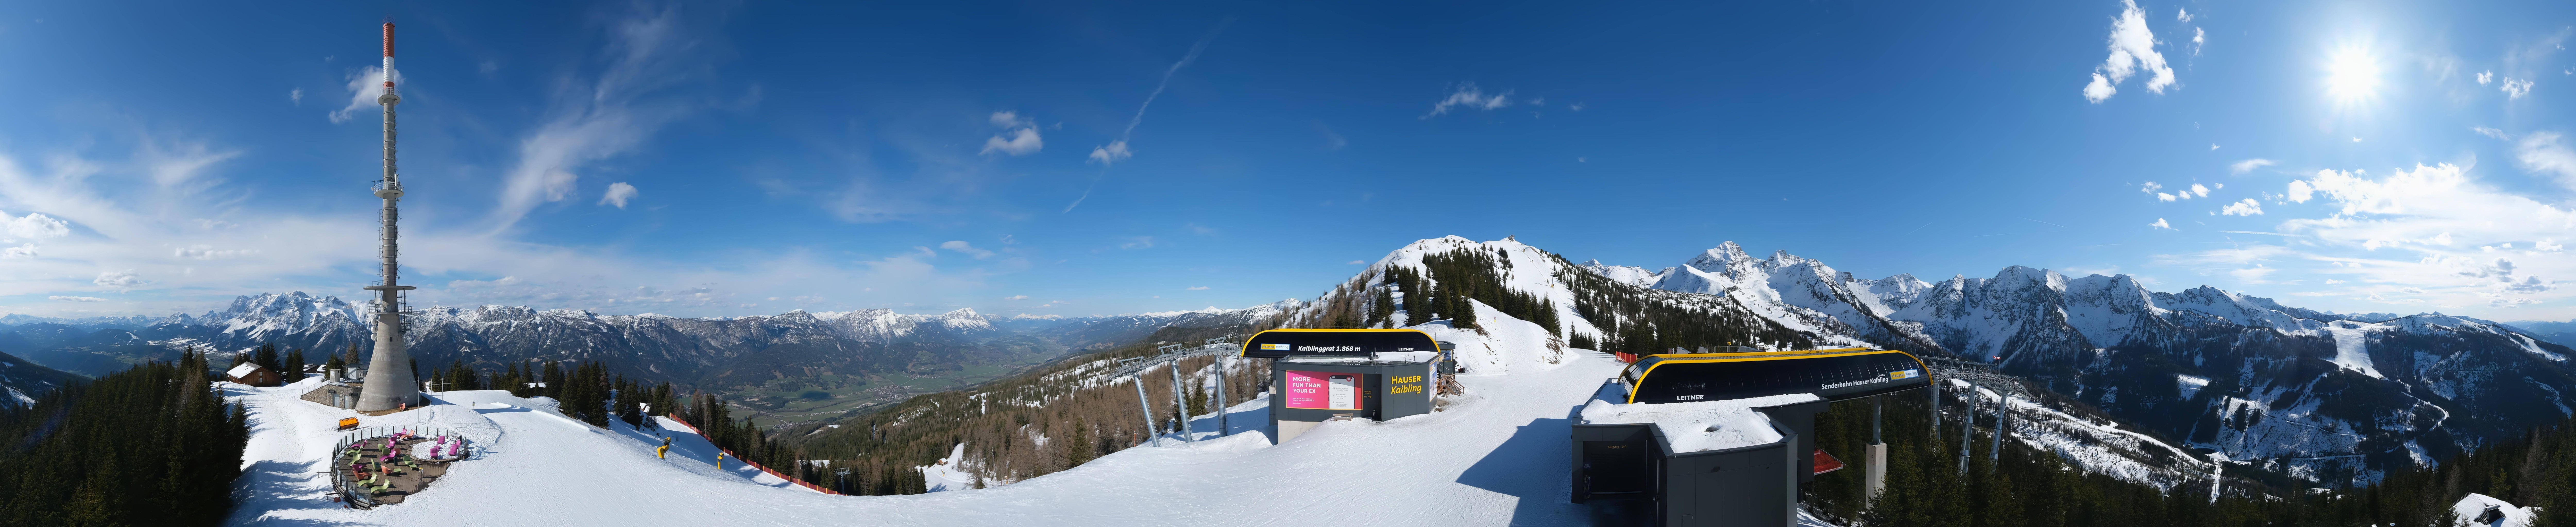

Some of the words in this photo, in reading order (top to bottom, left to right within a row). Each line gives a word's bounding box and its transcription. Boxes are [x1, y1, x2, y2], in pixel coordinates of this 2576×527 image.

[1392, 376, 1421, 384] HAUSER
[1391, 384, 1421, 394] Kaibling
[1822, 381, 1852, 390] Senderbahn
